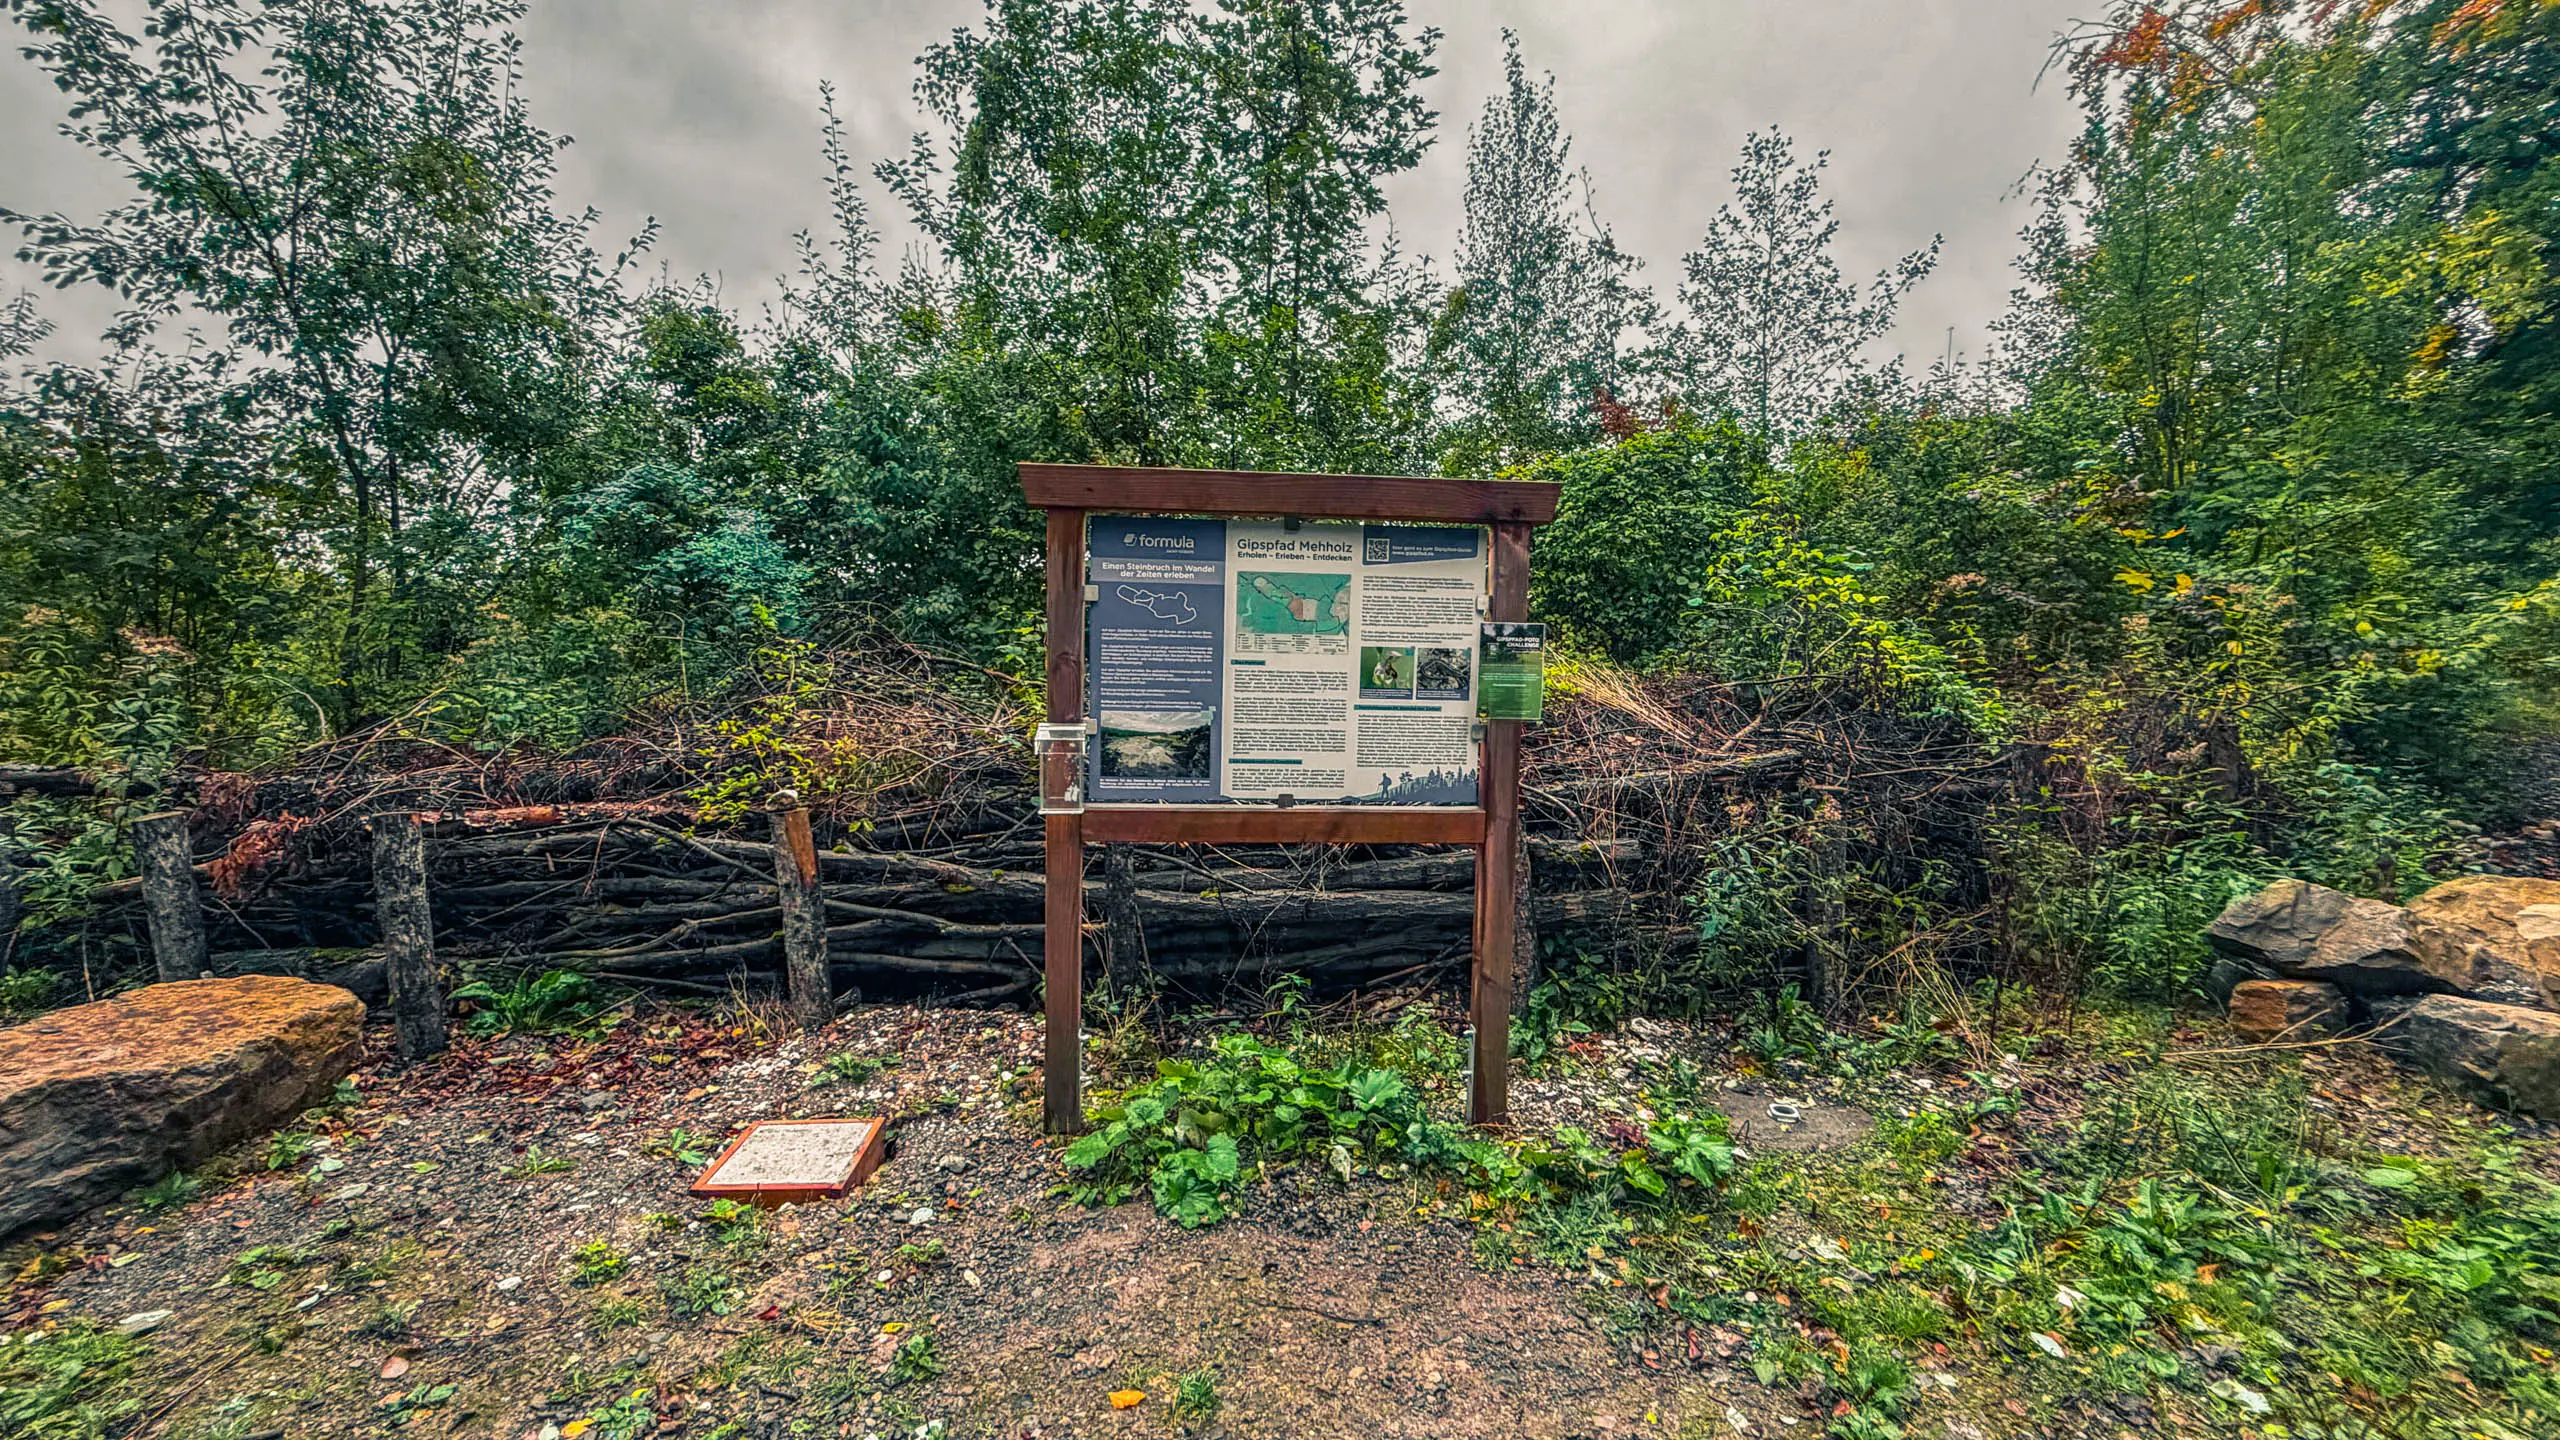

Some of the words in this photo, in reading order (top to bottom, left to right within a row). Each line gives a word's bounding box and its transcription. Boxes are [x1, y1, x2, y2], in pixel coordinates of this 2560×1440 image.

[1139, 534, 1195, 548] formula
[1237, 538, 1295, 552] Gipspfad
[1299, 541, 1353, 553] Mehholz
[1275, 552, 1304, 560] Erleben
[1313, 553, 1353, 561] Entdecken
[1102, 562, 1125, 570] Einen
[1127, 562, 1171, 571] Steinbruch
[1184, 564, 1215, 573] Wandel
[1164, 571, 1195, 579] erleben
